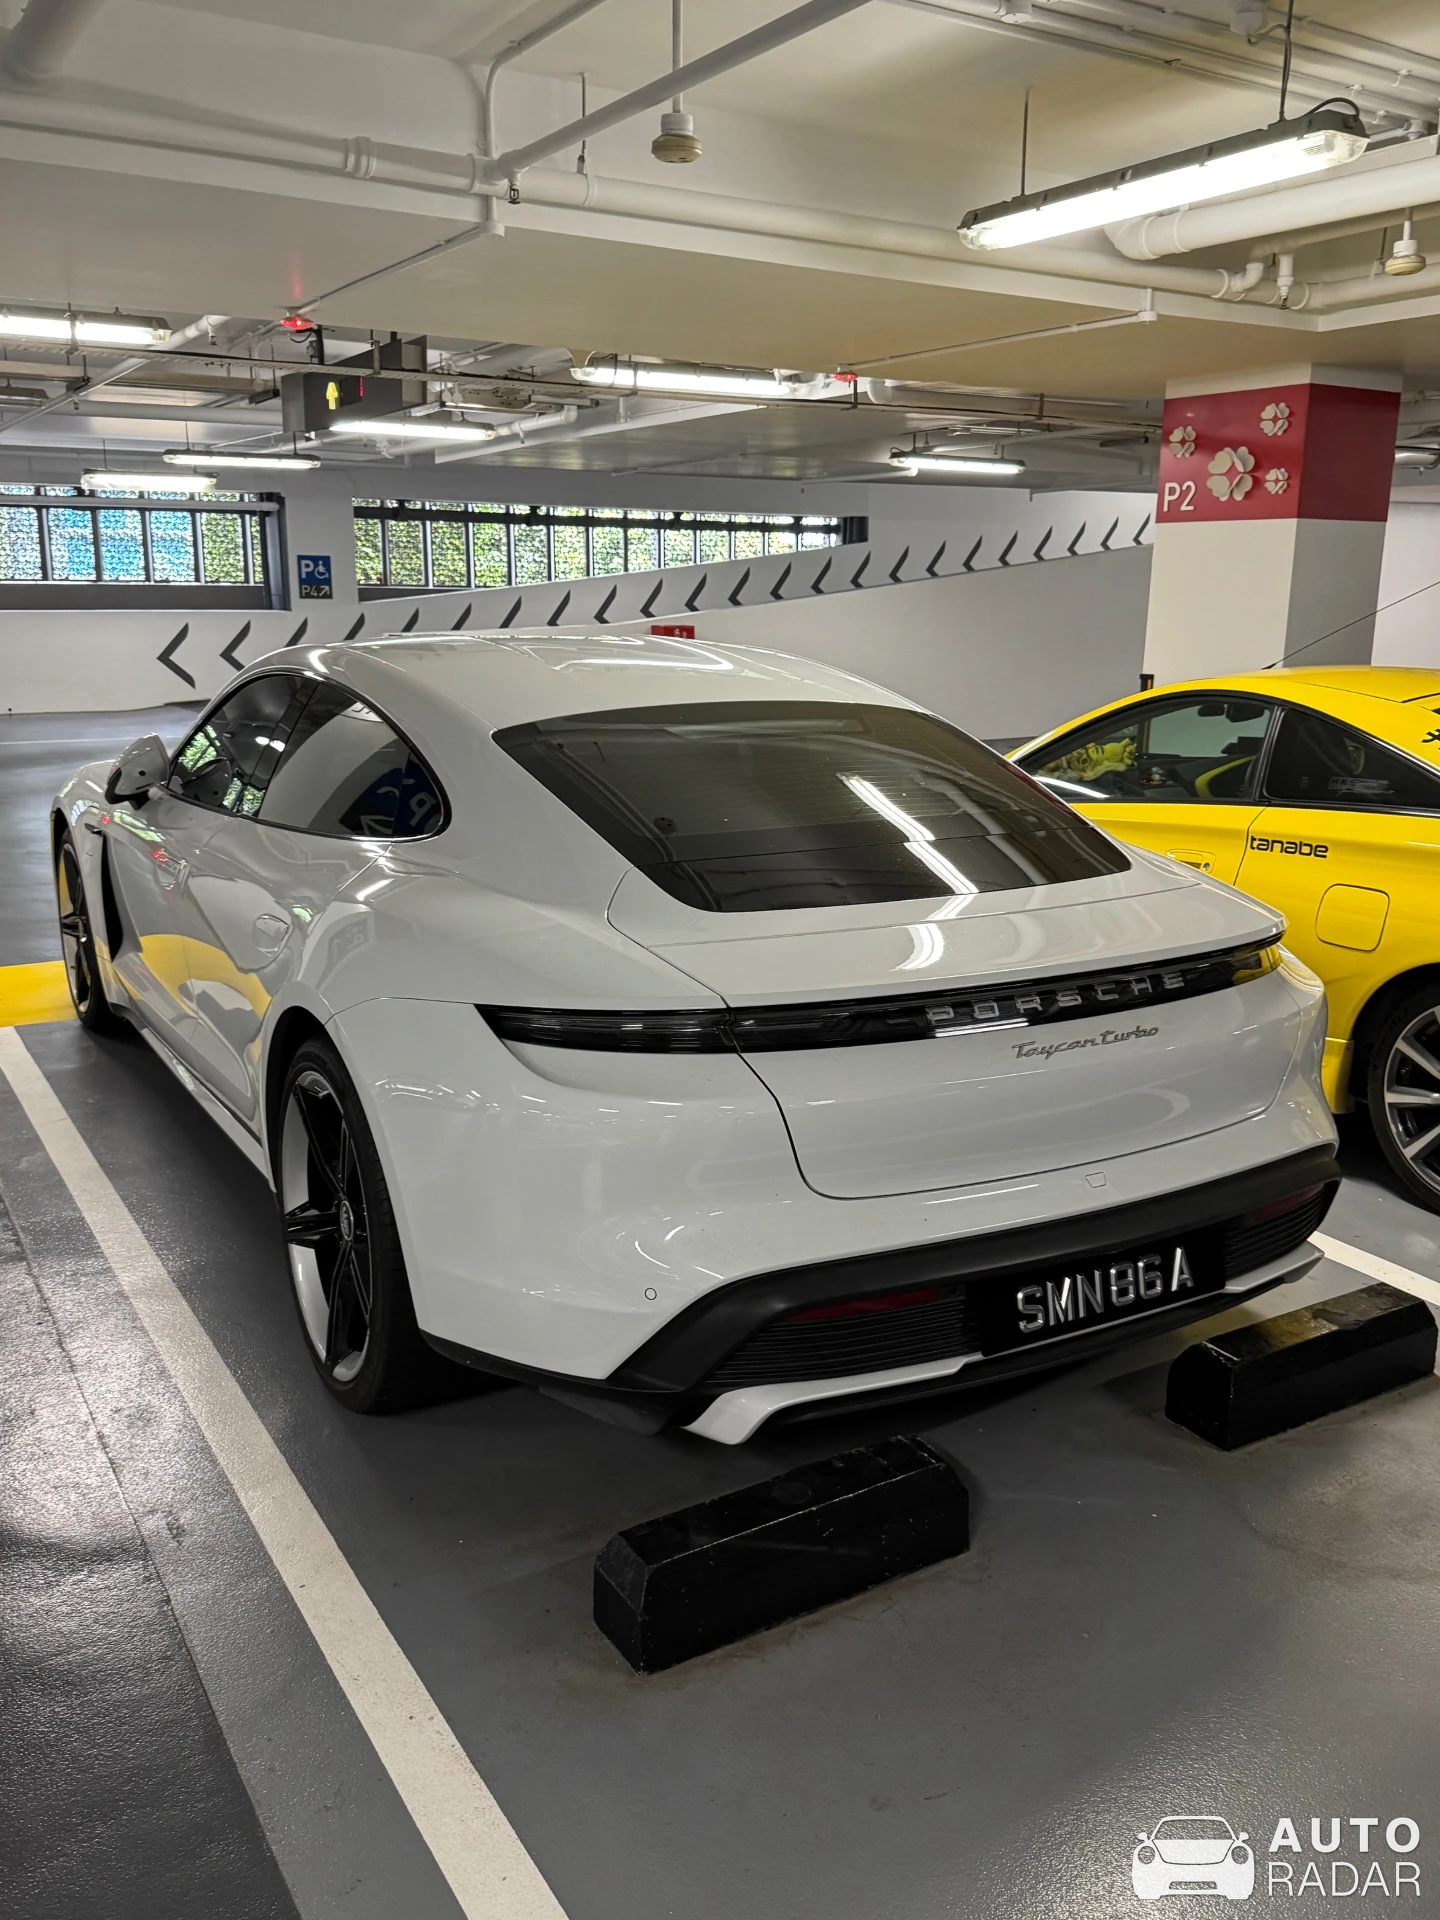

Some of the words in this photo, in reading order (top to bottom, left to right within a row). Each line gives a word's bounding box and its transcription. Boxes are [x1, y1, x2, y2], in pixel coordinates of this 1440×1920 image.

[1163, 481, 1196, 512] P2
[301, 560, 314, 579] P
[301, 585, 318, 597] P4
[1250, 835, 1329, 859] tanabe
[925, 971, 1185, 1026] PORSCHE
[1011, 1036, 1099, 1060] Taycan
